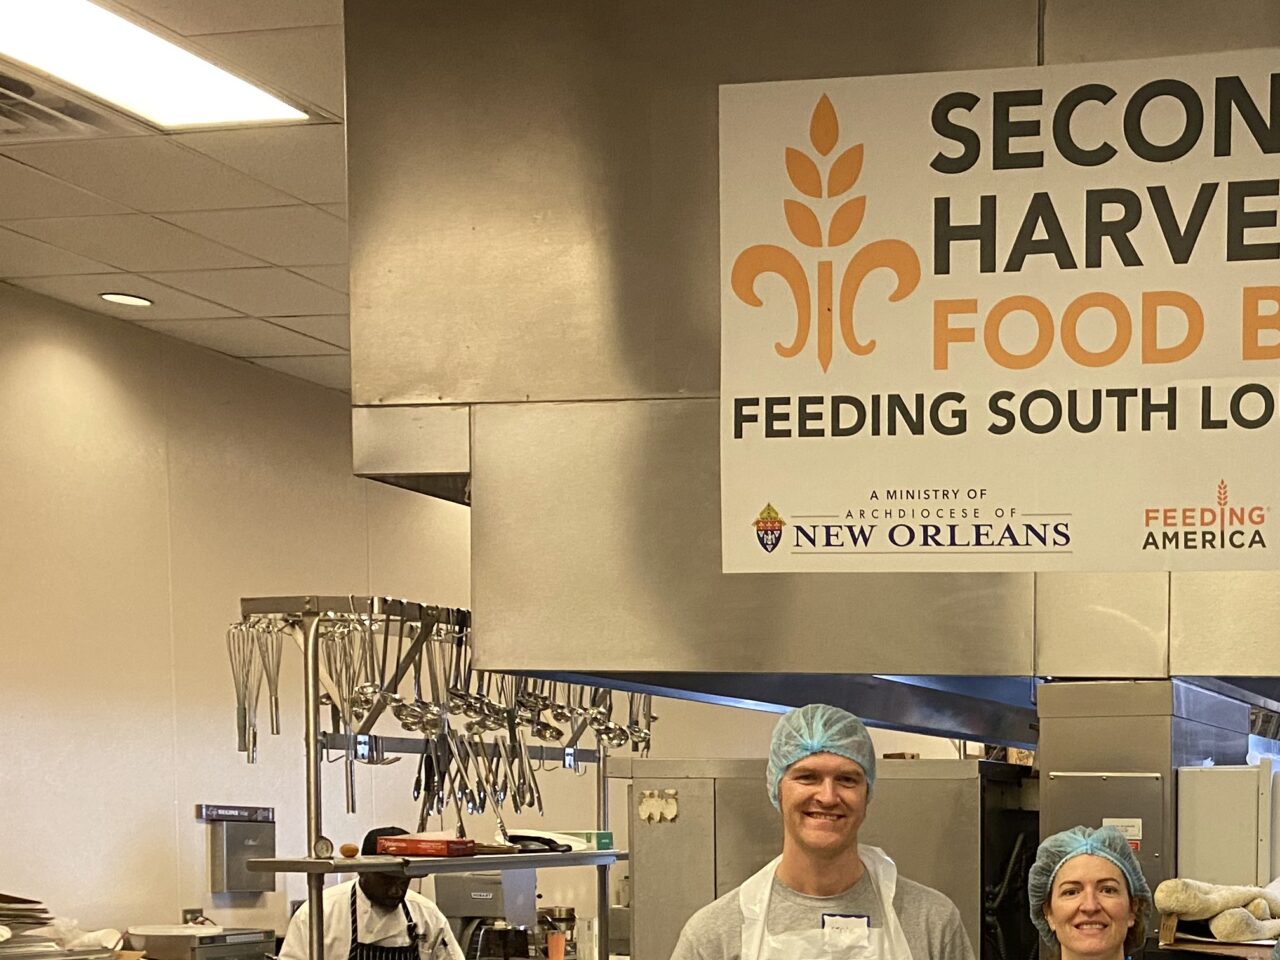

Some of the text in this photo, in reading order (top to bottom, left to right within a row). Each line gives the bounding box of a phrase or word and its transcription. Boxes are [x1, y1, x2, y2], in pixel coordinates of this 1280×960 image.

[933, 290, 1205, 370] FOOD
[733, 391, 968, 440] FEEDING
[987, 386, 1177, 435] SOUTH
[869, 488, 988, 501] A MINISTRY OF
[845, 507, 1017, 520] ARCHDIOCESE OF
[1144, 505, 1266, 528] FEEDING
[792, 521, 1072, 548] NEW ORLEANS
[1142, 528, 1267, 550] AMERICA
